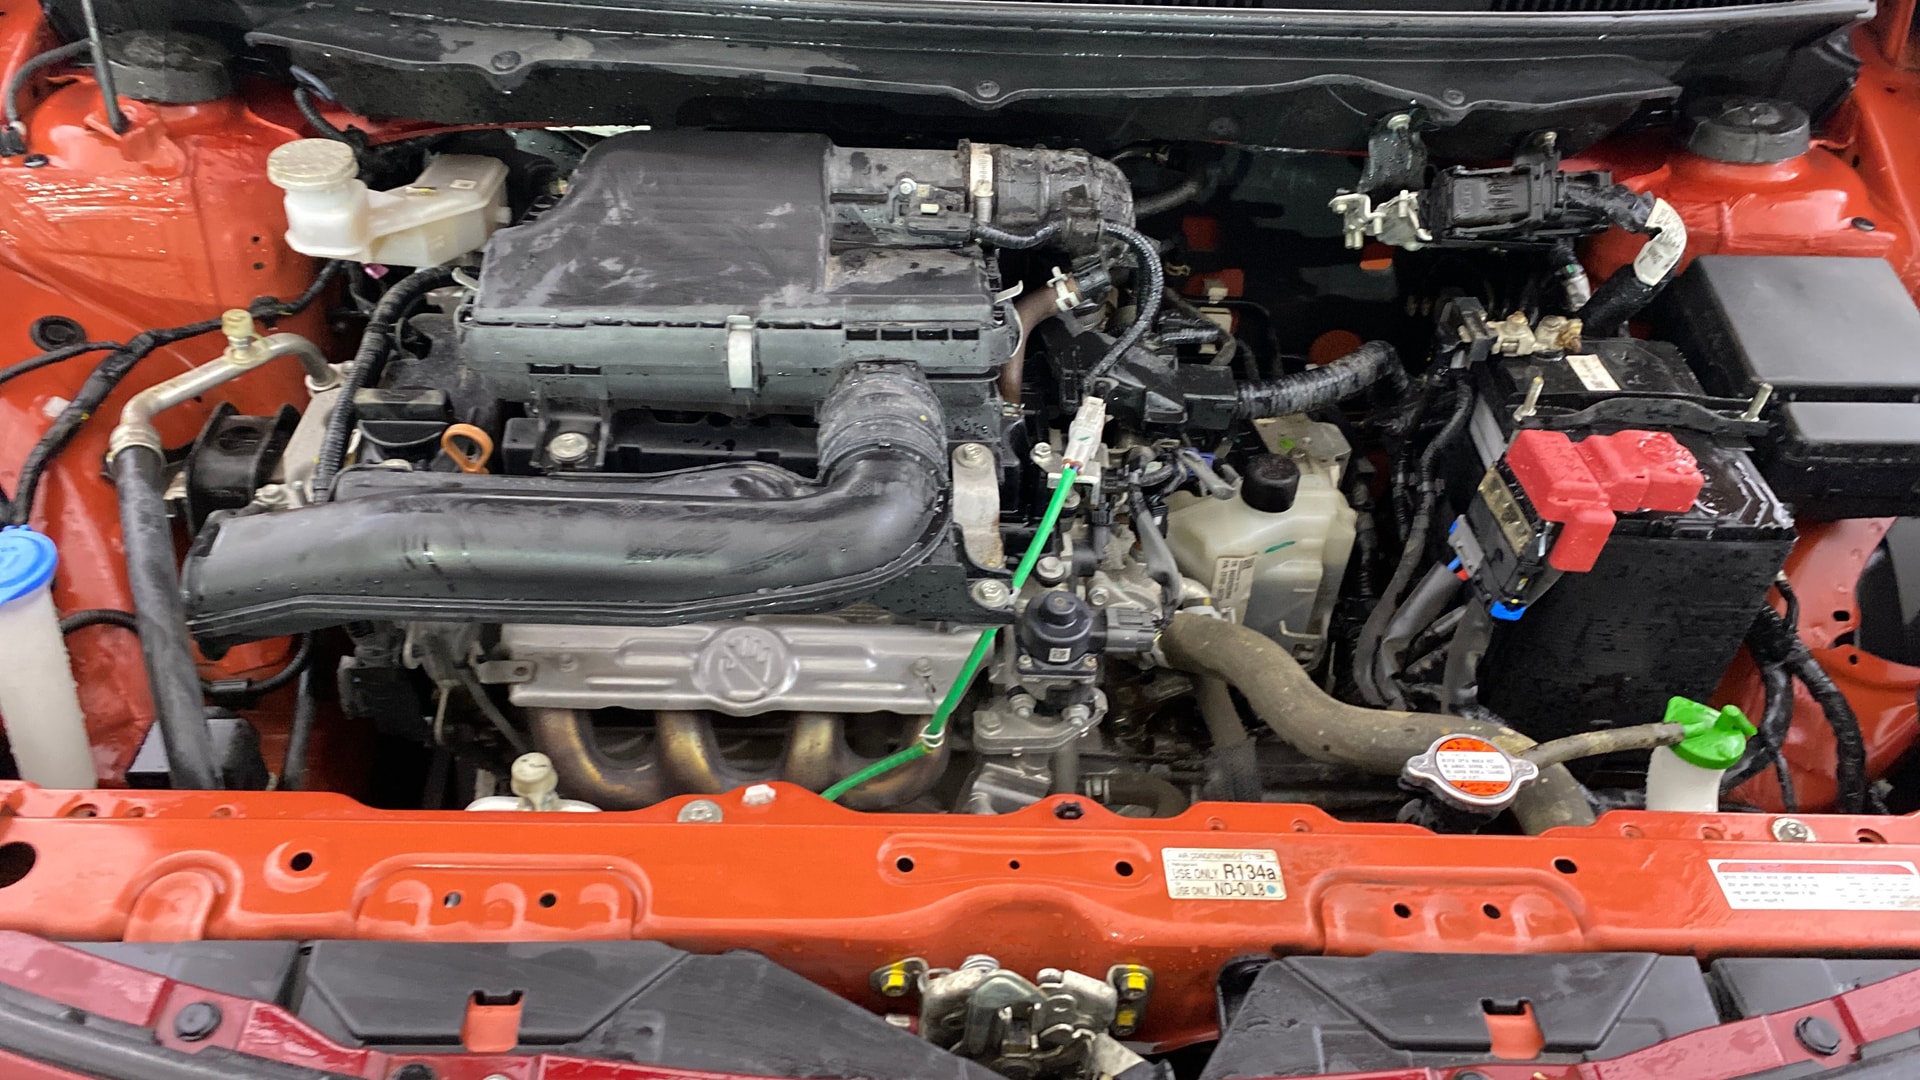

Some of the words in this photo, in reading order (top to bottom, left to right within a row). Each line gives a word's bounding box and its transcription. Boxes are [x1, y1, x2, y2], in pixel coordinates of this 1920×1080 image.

[1194, 868, 1218, 879] ONLY
[1223, 863, 1276, 880] R134a
[1191, 886, 1211, 895] ONLY
